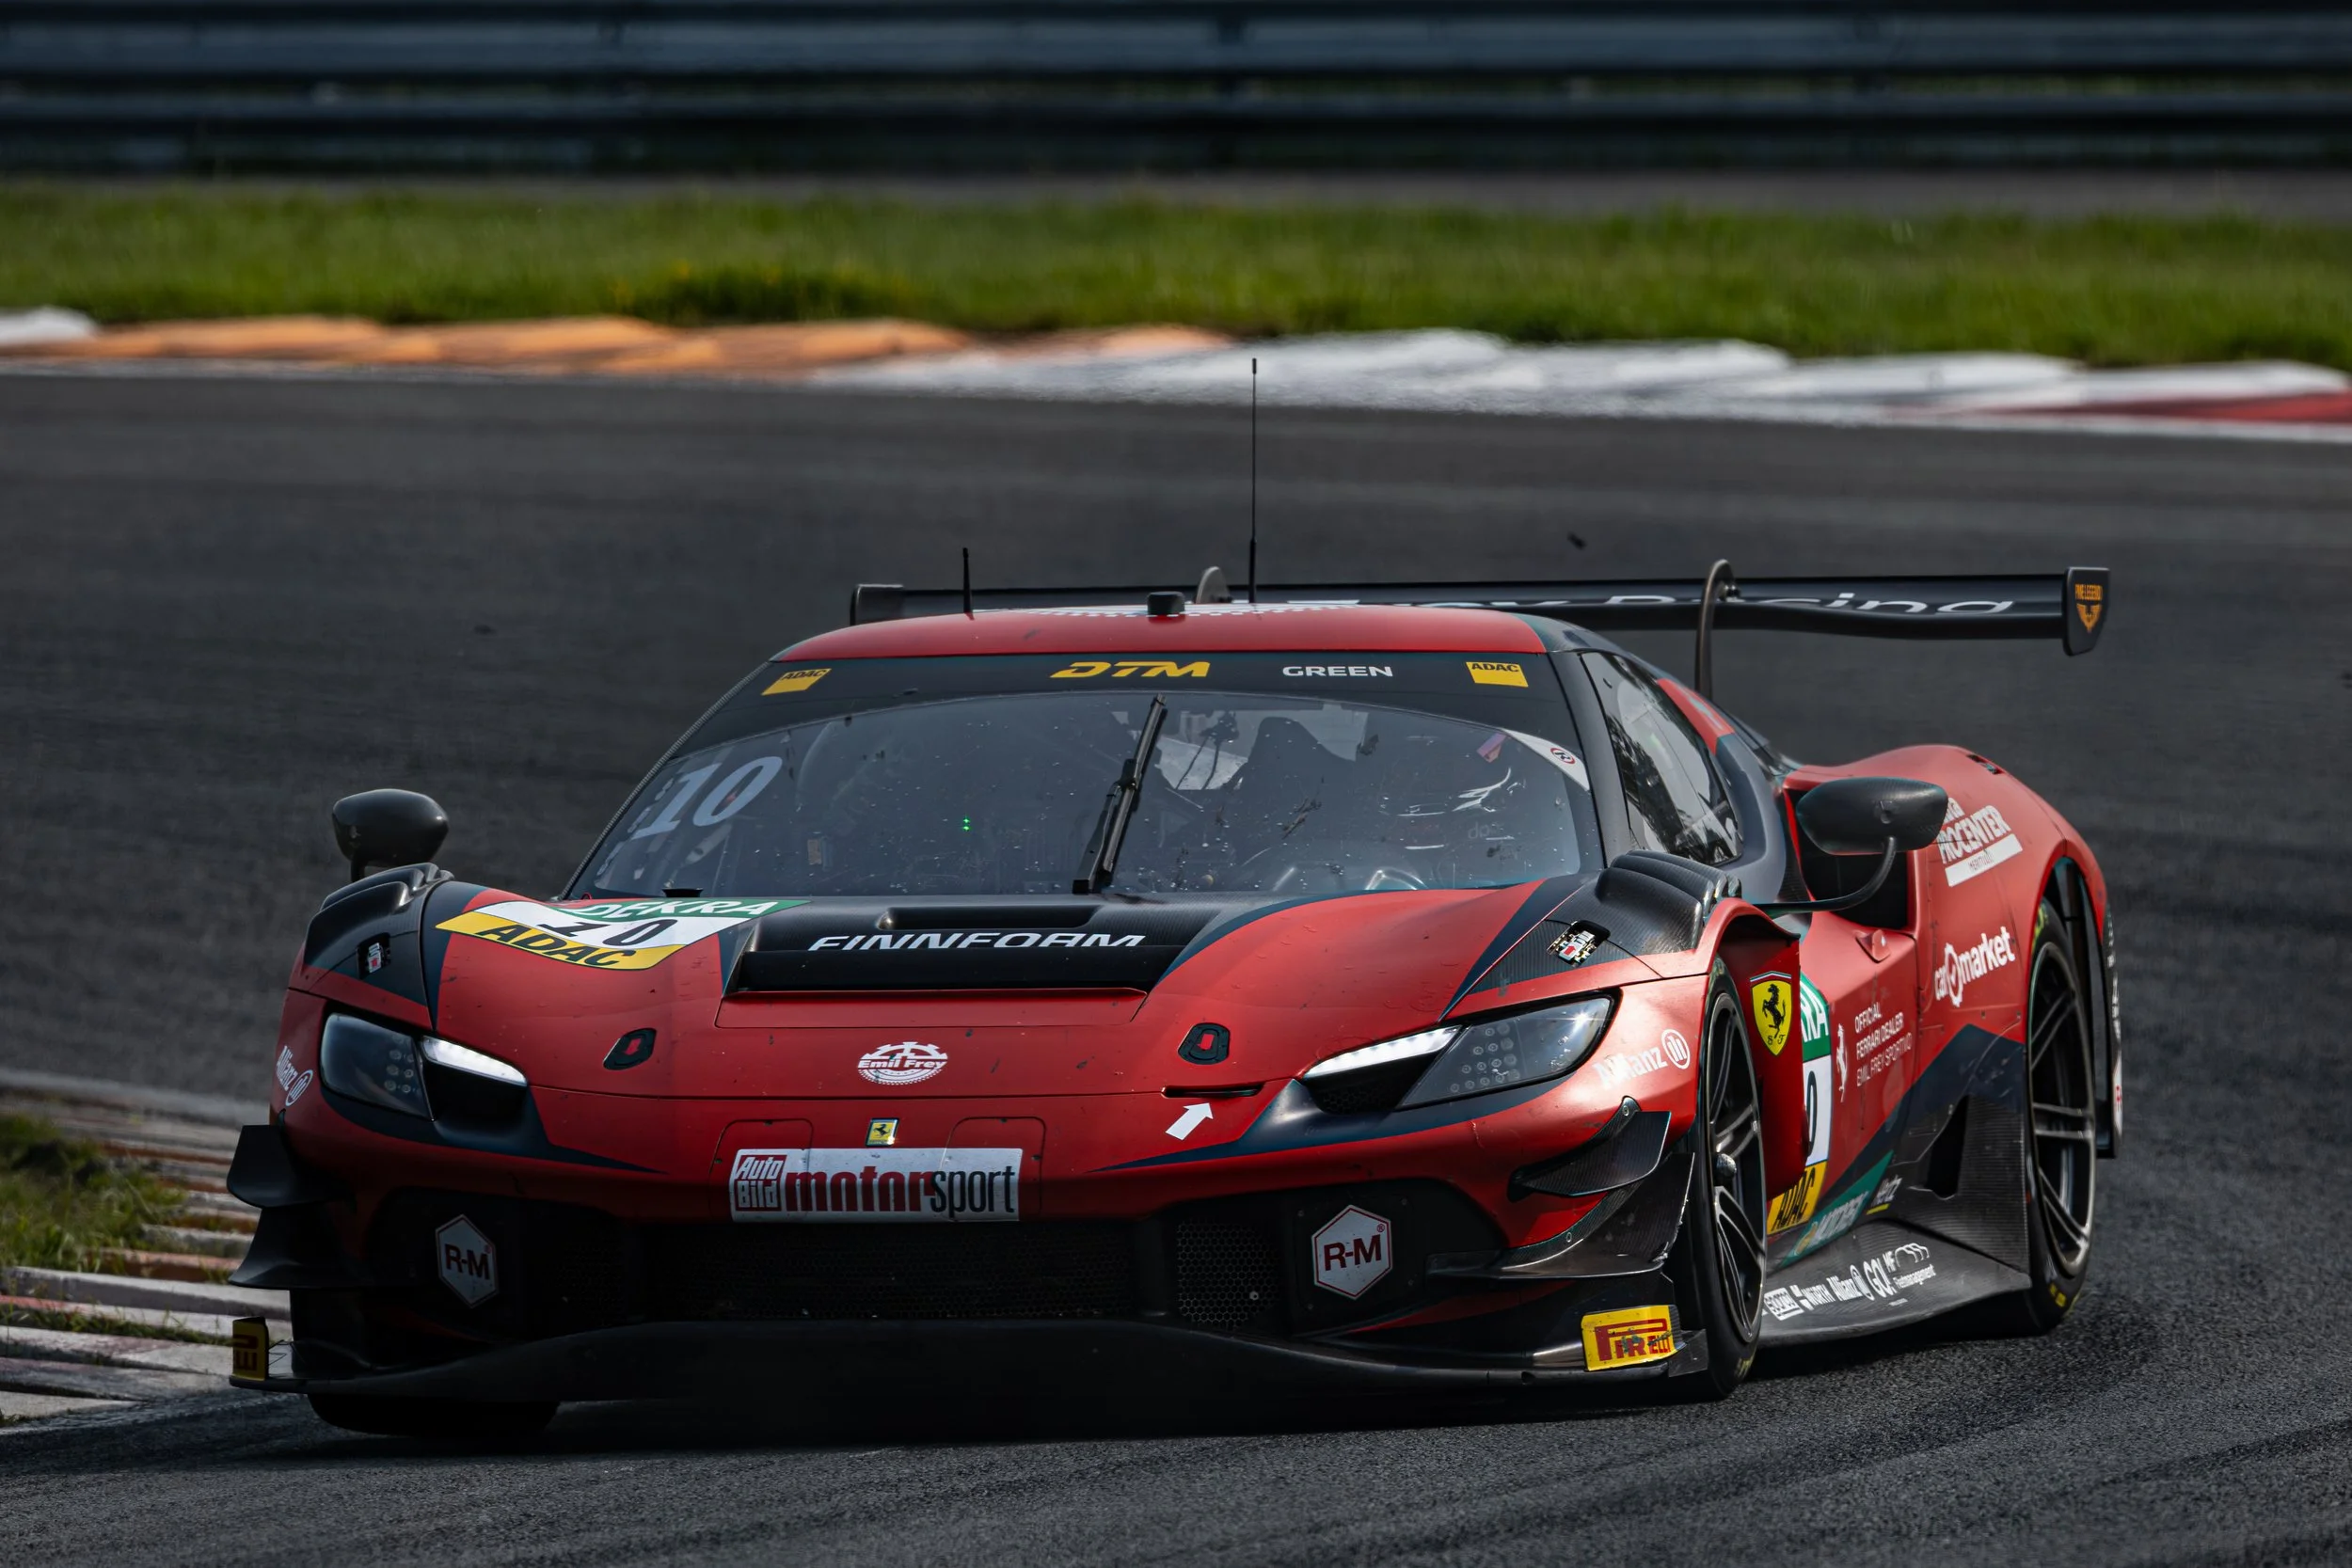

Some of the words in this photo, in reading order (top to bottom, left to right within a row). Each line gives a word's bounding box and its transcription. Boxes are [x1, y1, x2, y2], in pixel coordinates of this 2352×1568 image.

[780, 670, 827, 681] ADAC
[1050, 661, 1210, 678] DTM
[1282, 666, 1392, 677] GREEN
[1471, 663, 1519, 672] ADAC
[631, 756, 783, 840] 10
[1937, 805, 2012, 864] PROCENTER
[568, 900, 781, 919] DEKRA
[476, 925, 637, 966] ADAC
[536, 919, 678, 945] 10
[808, 932, 1146, 951] FINNFORM
[1854, 1002, 1882, 1034] OFFICIAL
[1856, 1029, 1881, 1060] FERRARI
[1882, 1011, 1904, 1042] DEALER
[857, 1060, 900, 1069] Emil
[904, 1060, 947, 1069] Frey
[1592, 1047, 1668, 1089] Allianz
[737, 1156, 786, 1180] Auto
[738, 1180, 779, 1209] Bild
[785, 1165, 1016, 1217] motorsport
[1594, 1318, 1672, 1361] PIRELLI
